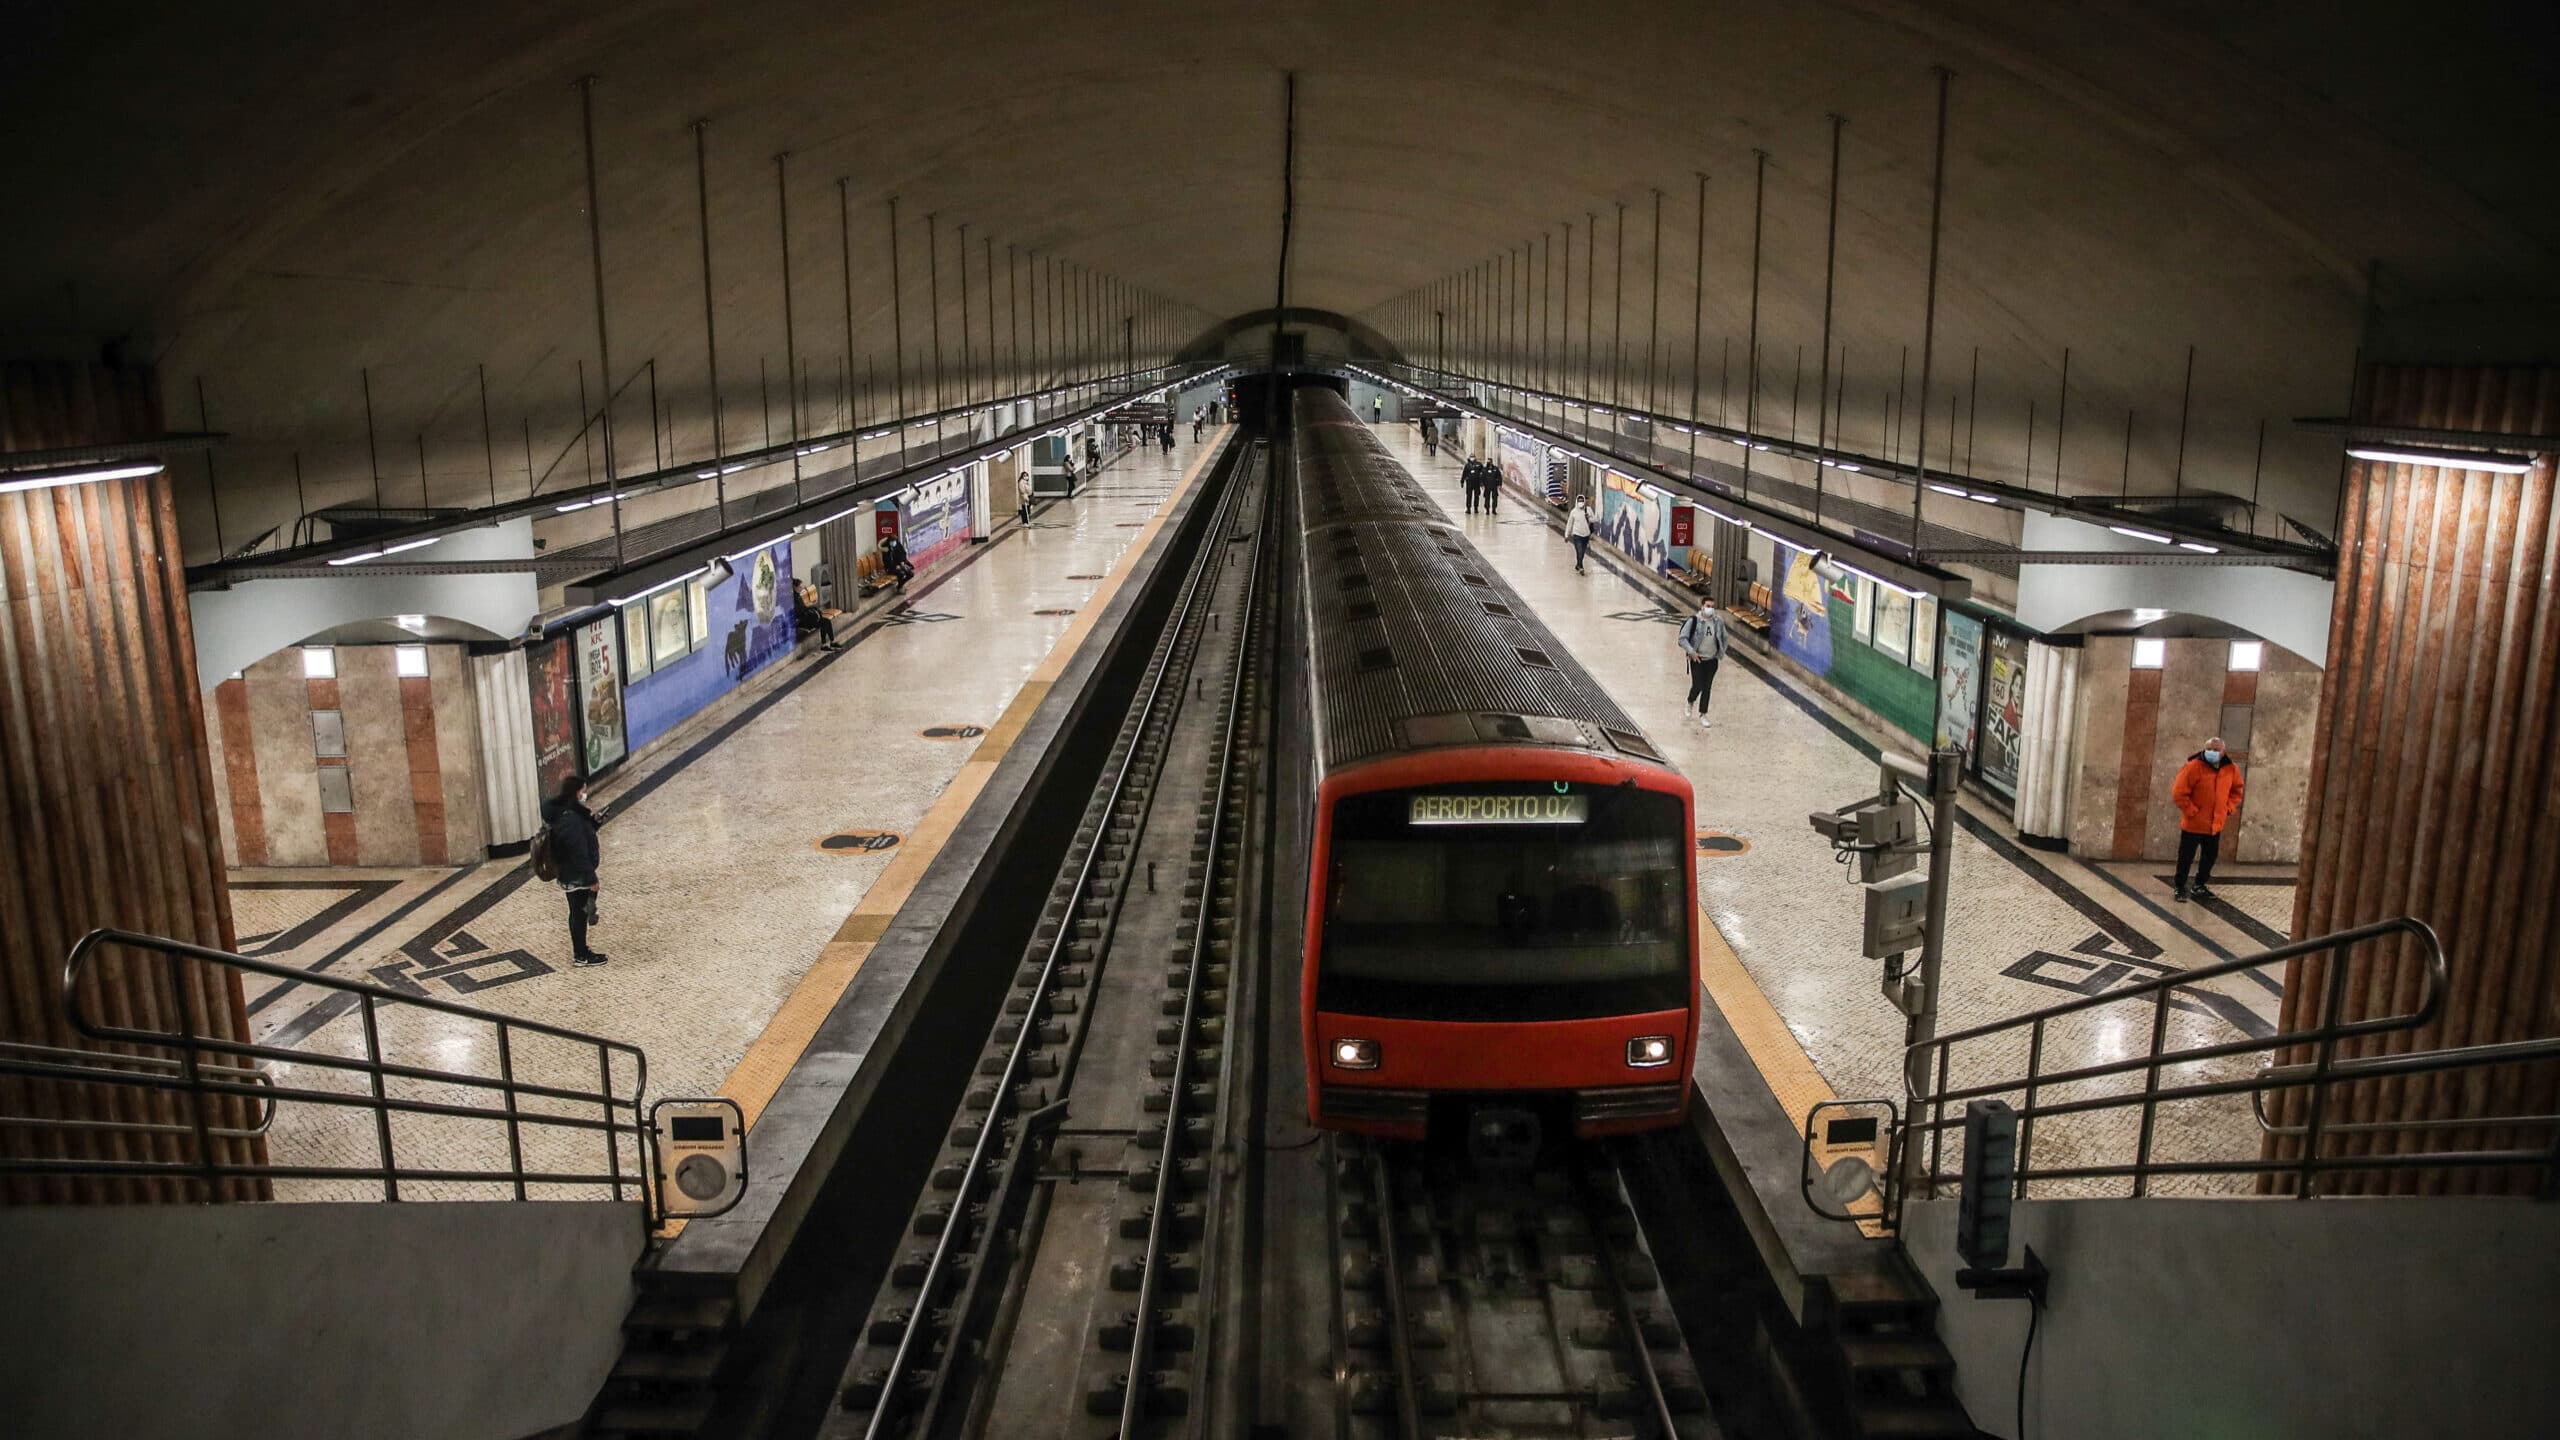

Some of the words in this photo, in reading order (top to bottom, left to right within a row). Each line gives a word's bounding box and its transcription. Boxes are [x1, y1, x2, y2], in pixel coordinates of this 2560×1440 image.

[590, 632, 602, 646] KFC
[1706, 626, 1713, 636] A
[601, 644, 610, 675] 5
[1413, 795, 1538, 820] AEROPORTO
[1546, 795, 1574, 818] 07
